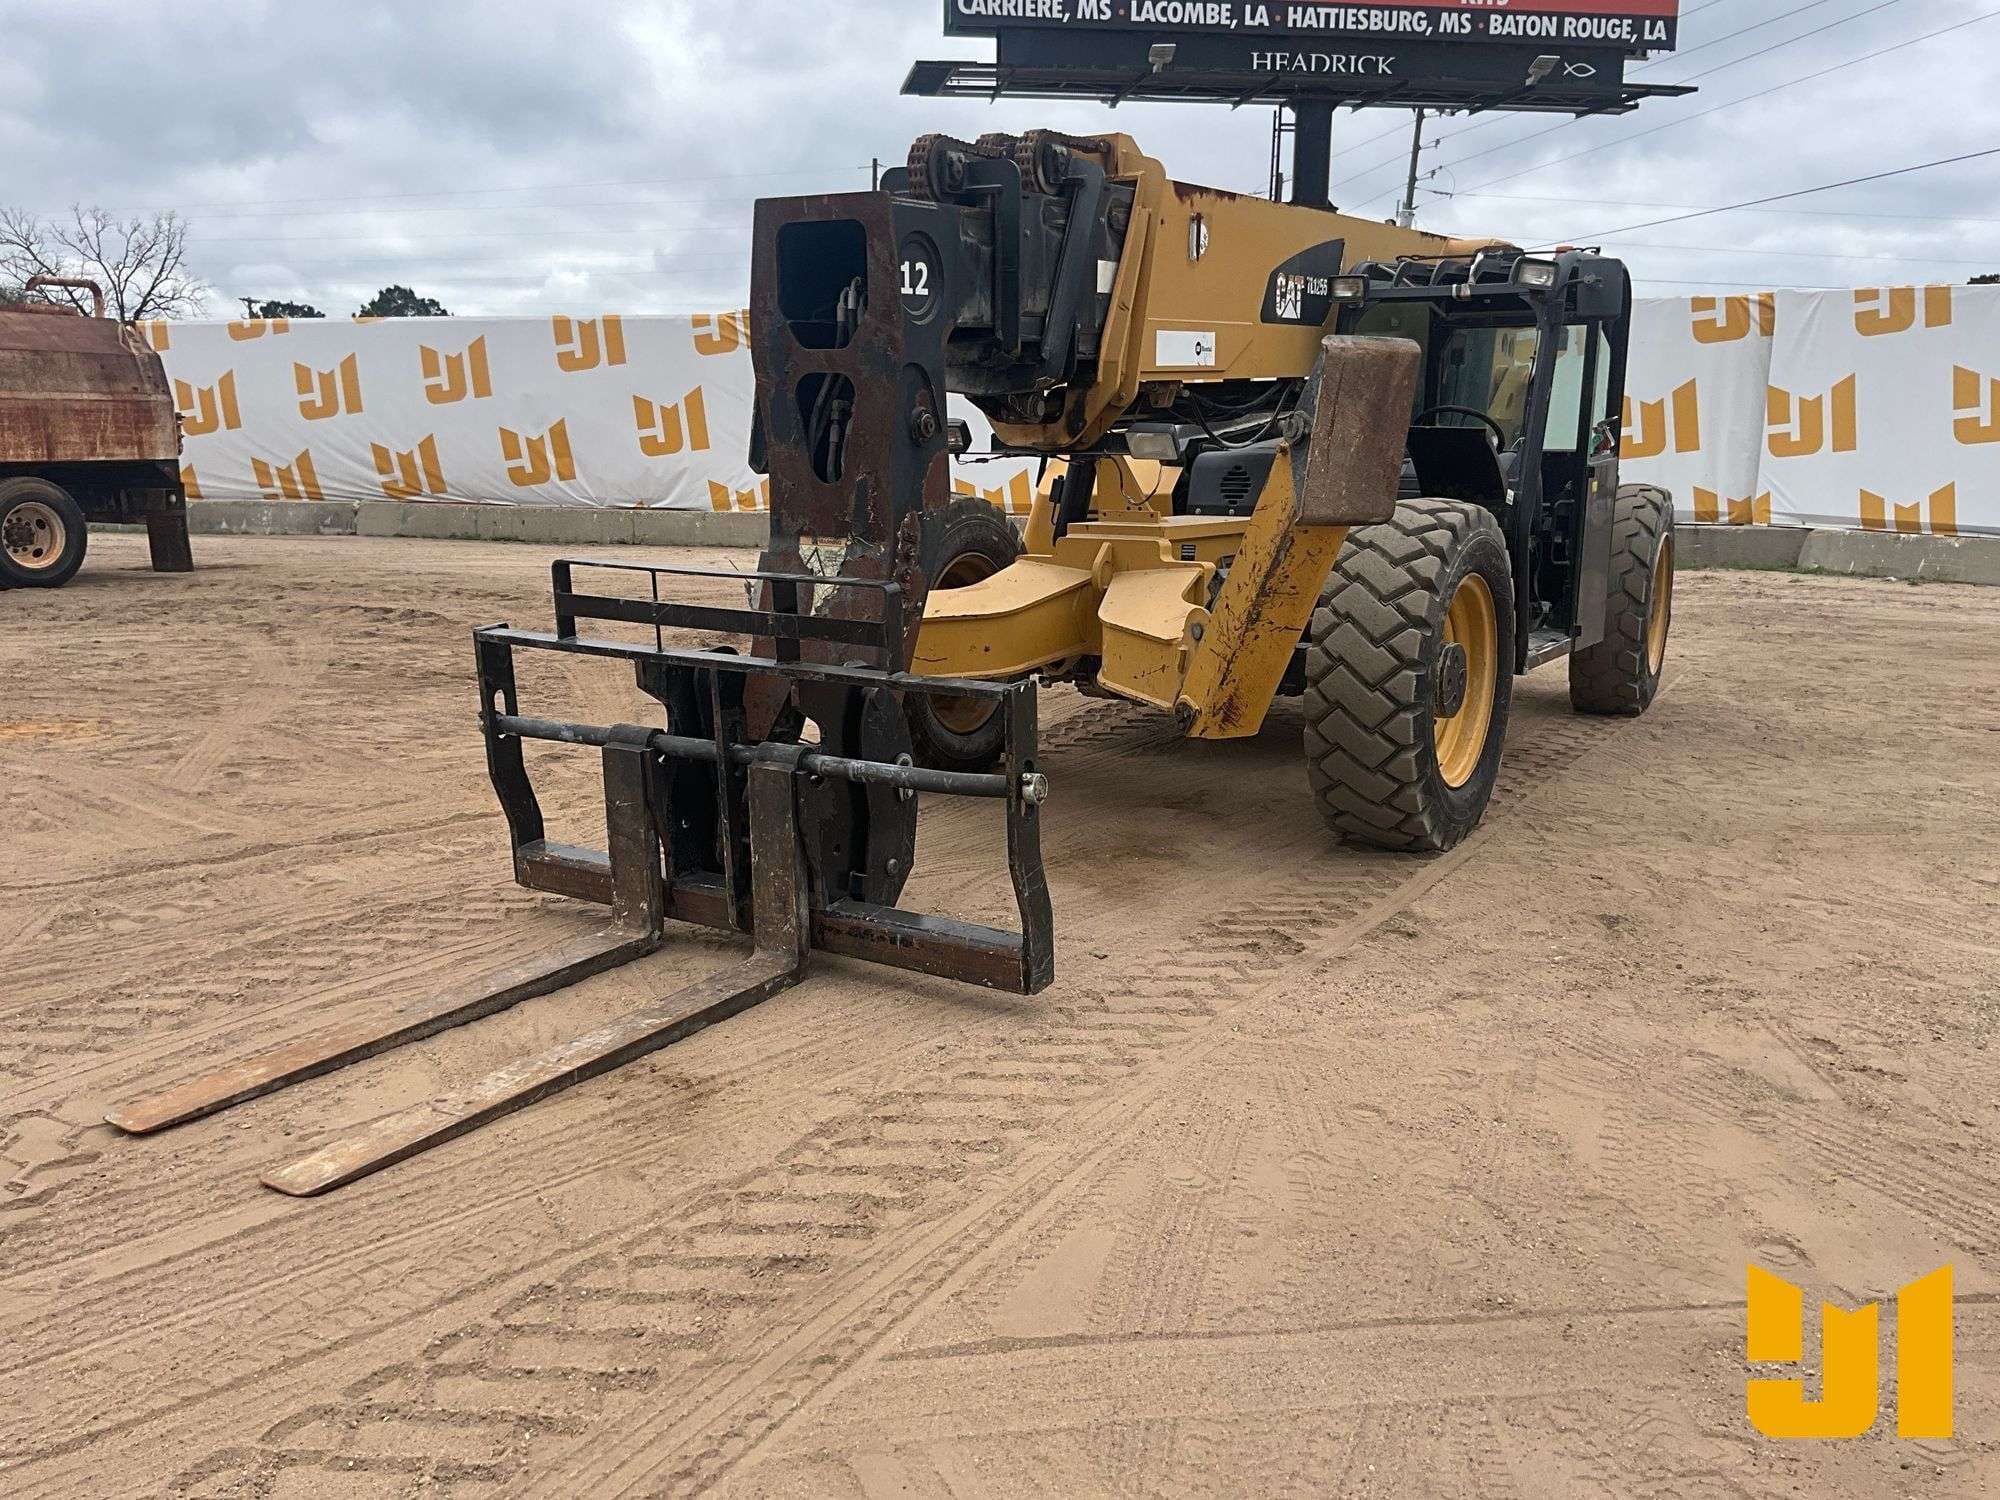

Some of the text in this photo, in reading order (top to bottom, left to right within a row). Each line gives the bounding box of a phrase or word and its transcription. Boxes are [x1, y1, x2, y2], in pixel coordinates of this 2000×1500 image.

[957, 0, 1667, 43] CARRIERE, MS LACOMBE, LA HATTIESBURG, MS BATON ROUGE, LA
[1250, 51, 1396, 75] HEADRICK
[899, 260, 929, 296] 12
